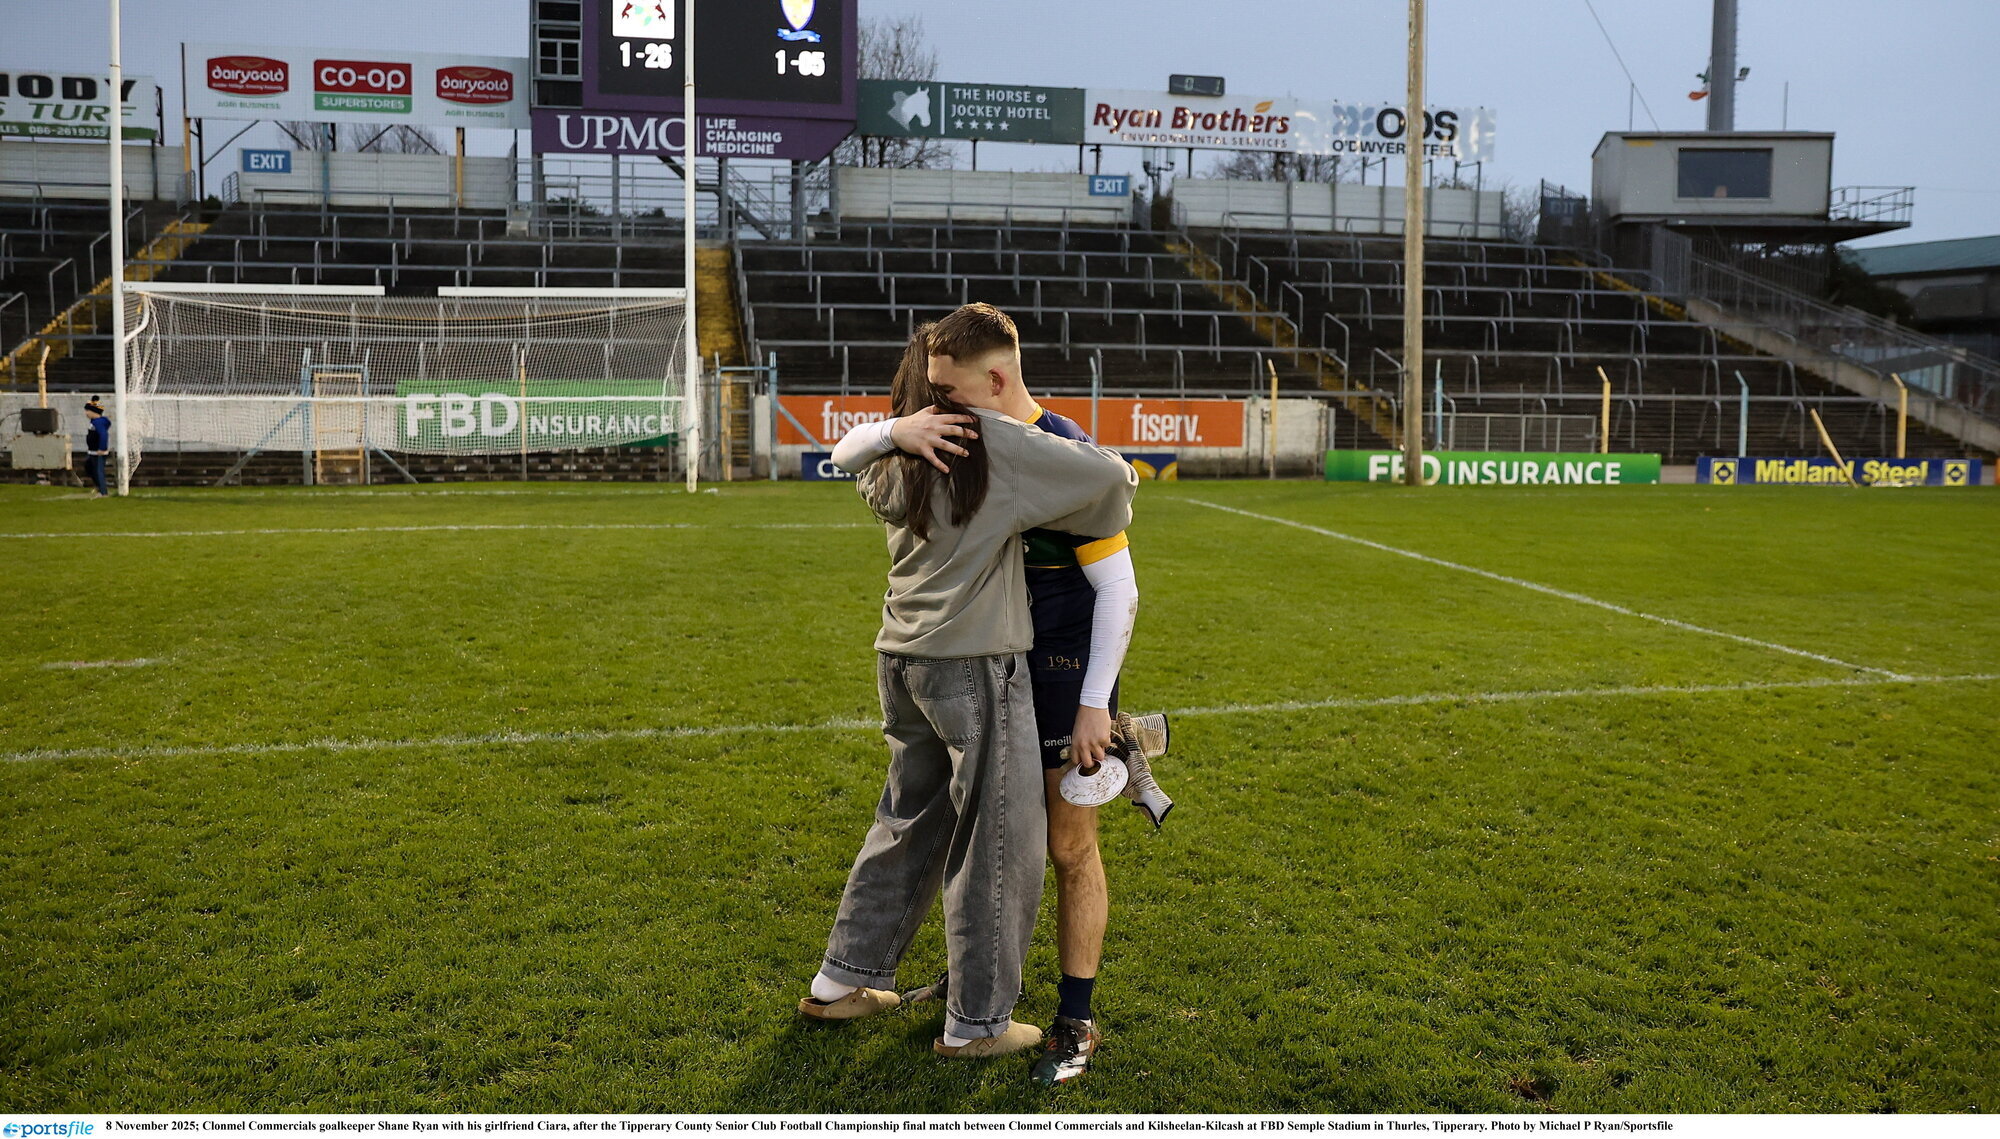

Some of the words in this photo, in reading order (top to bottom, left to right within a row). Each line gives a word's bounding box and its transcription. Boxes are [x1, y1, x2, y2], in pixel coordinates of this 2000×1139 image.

[0, 74, 136, 101] ODY
[322, 96, 405, 110] SUPERSTORES
[953, 88, 980, 100] THE
[985, 89, 1031, 103] HORSE
[951, 104, 1002, 118] JOCKEY
[1006, 106, 1051, 120] HOTEL
[1093, 103, 1162, 134] Ryan
[1171, 106, 1290, 134] Brothers
[705, 118, 737, 130] LIFE
[706, 130, 783, 143] CHANGING
[706, 142, 775, 155] MEDICINE
[250, 153, 286, 169] EXIT
[1094, 179, 1125, 194] EXIT
[406, 393, 519, 437] FBD
[530, 415, 674, 435] NSURANCE
[1448, 460, 1622, 485] INSURANCE
[1755, 459, 1855, 483] Midland
[1862, 461, 1929, 484] Steel
[1047, 656, 1081, 671] 1934
